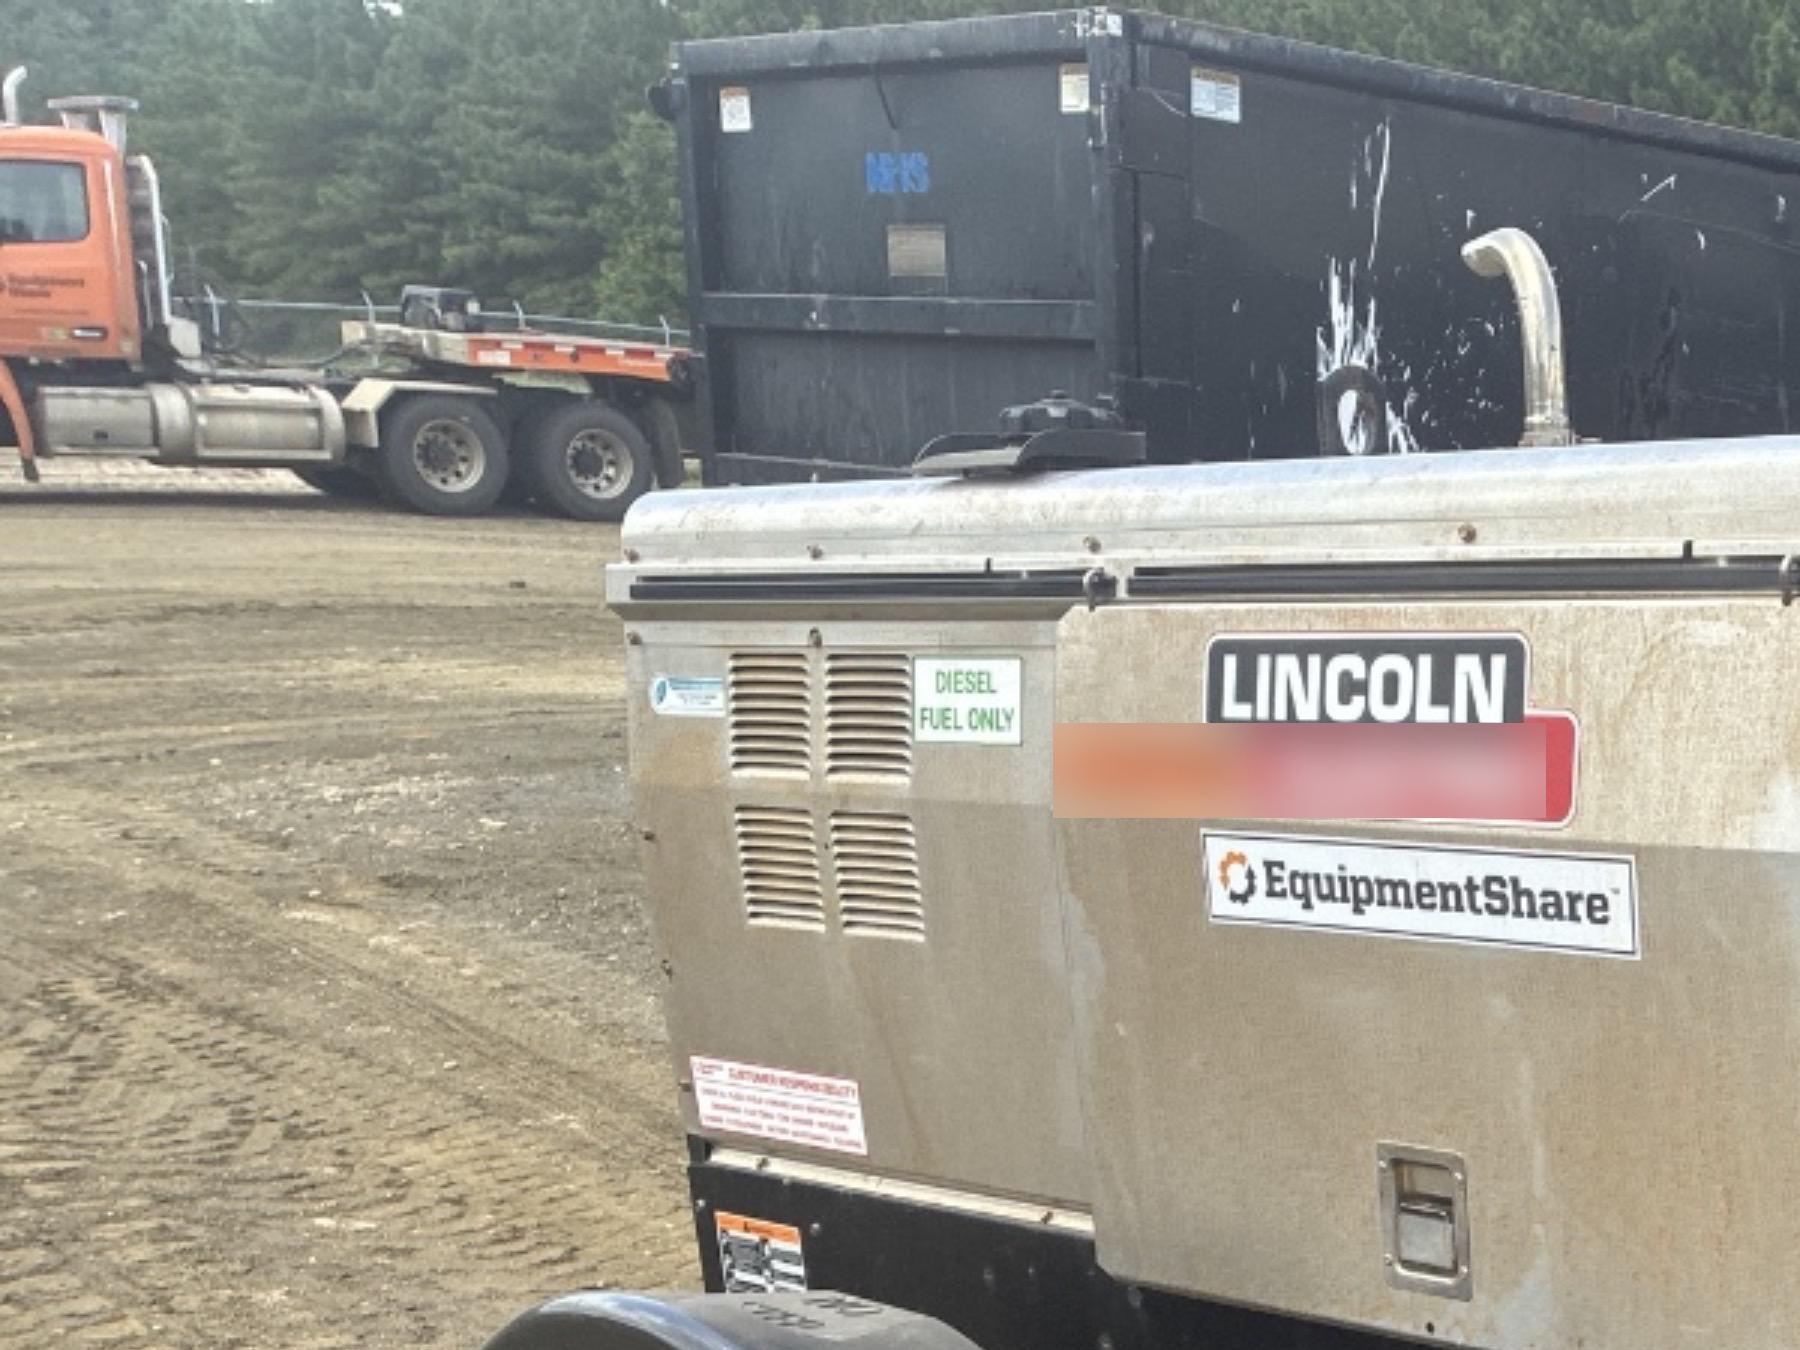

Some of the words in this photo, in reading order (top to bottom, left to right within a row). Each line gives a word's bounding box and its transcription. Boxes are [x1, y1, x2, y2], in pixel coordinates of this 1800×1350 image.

[936, 669, 997, 694] DIESEL
[1222, 652, 1507, 723] LINCOLN
[920, 706, 963, 731] FUEL
[968, 707, 1014, 733] ONLY
[1263, 859, 1612, 925] EquipmentShare
